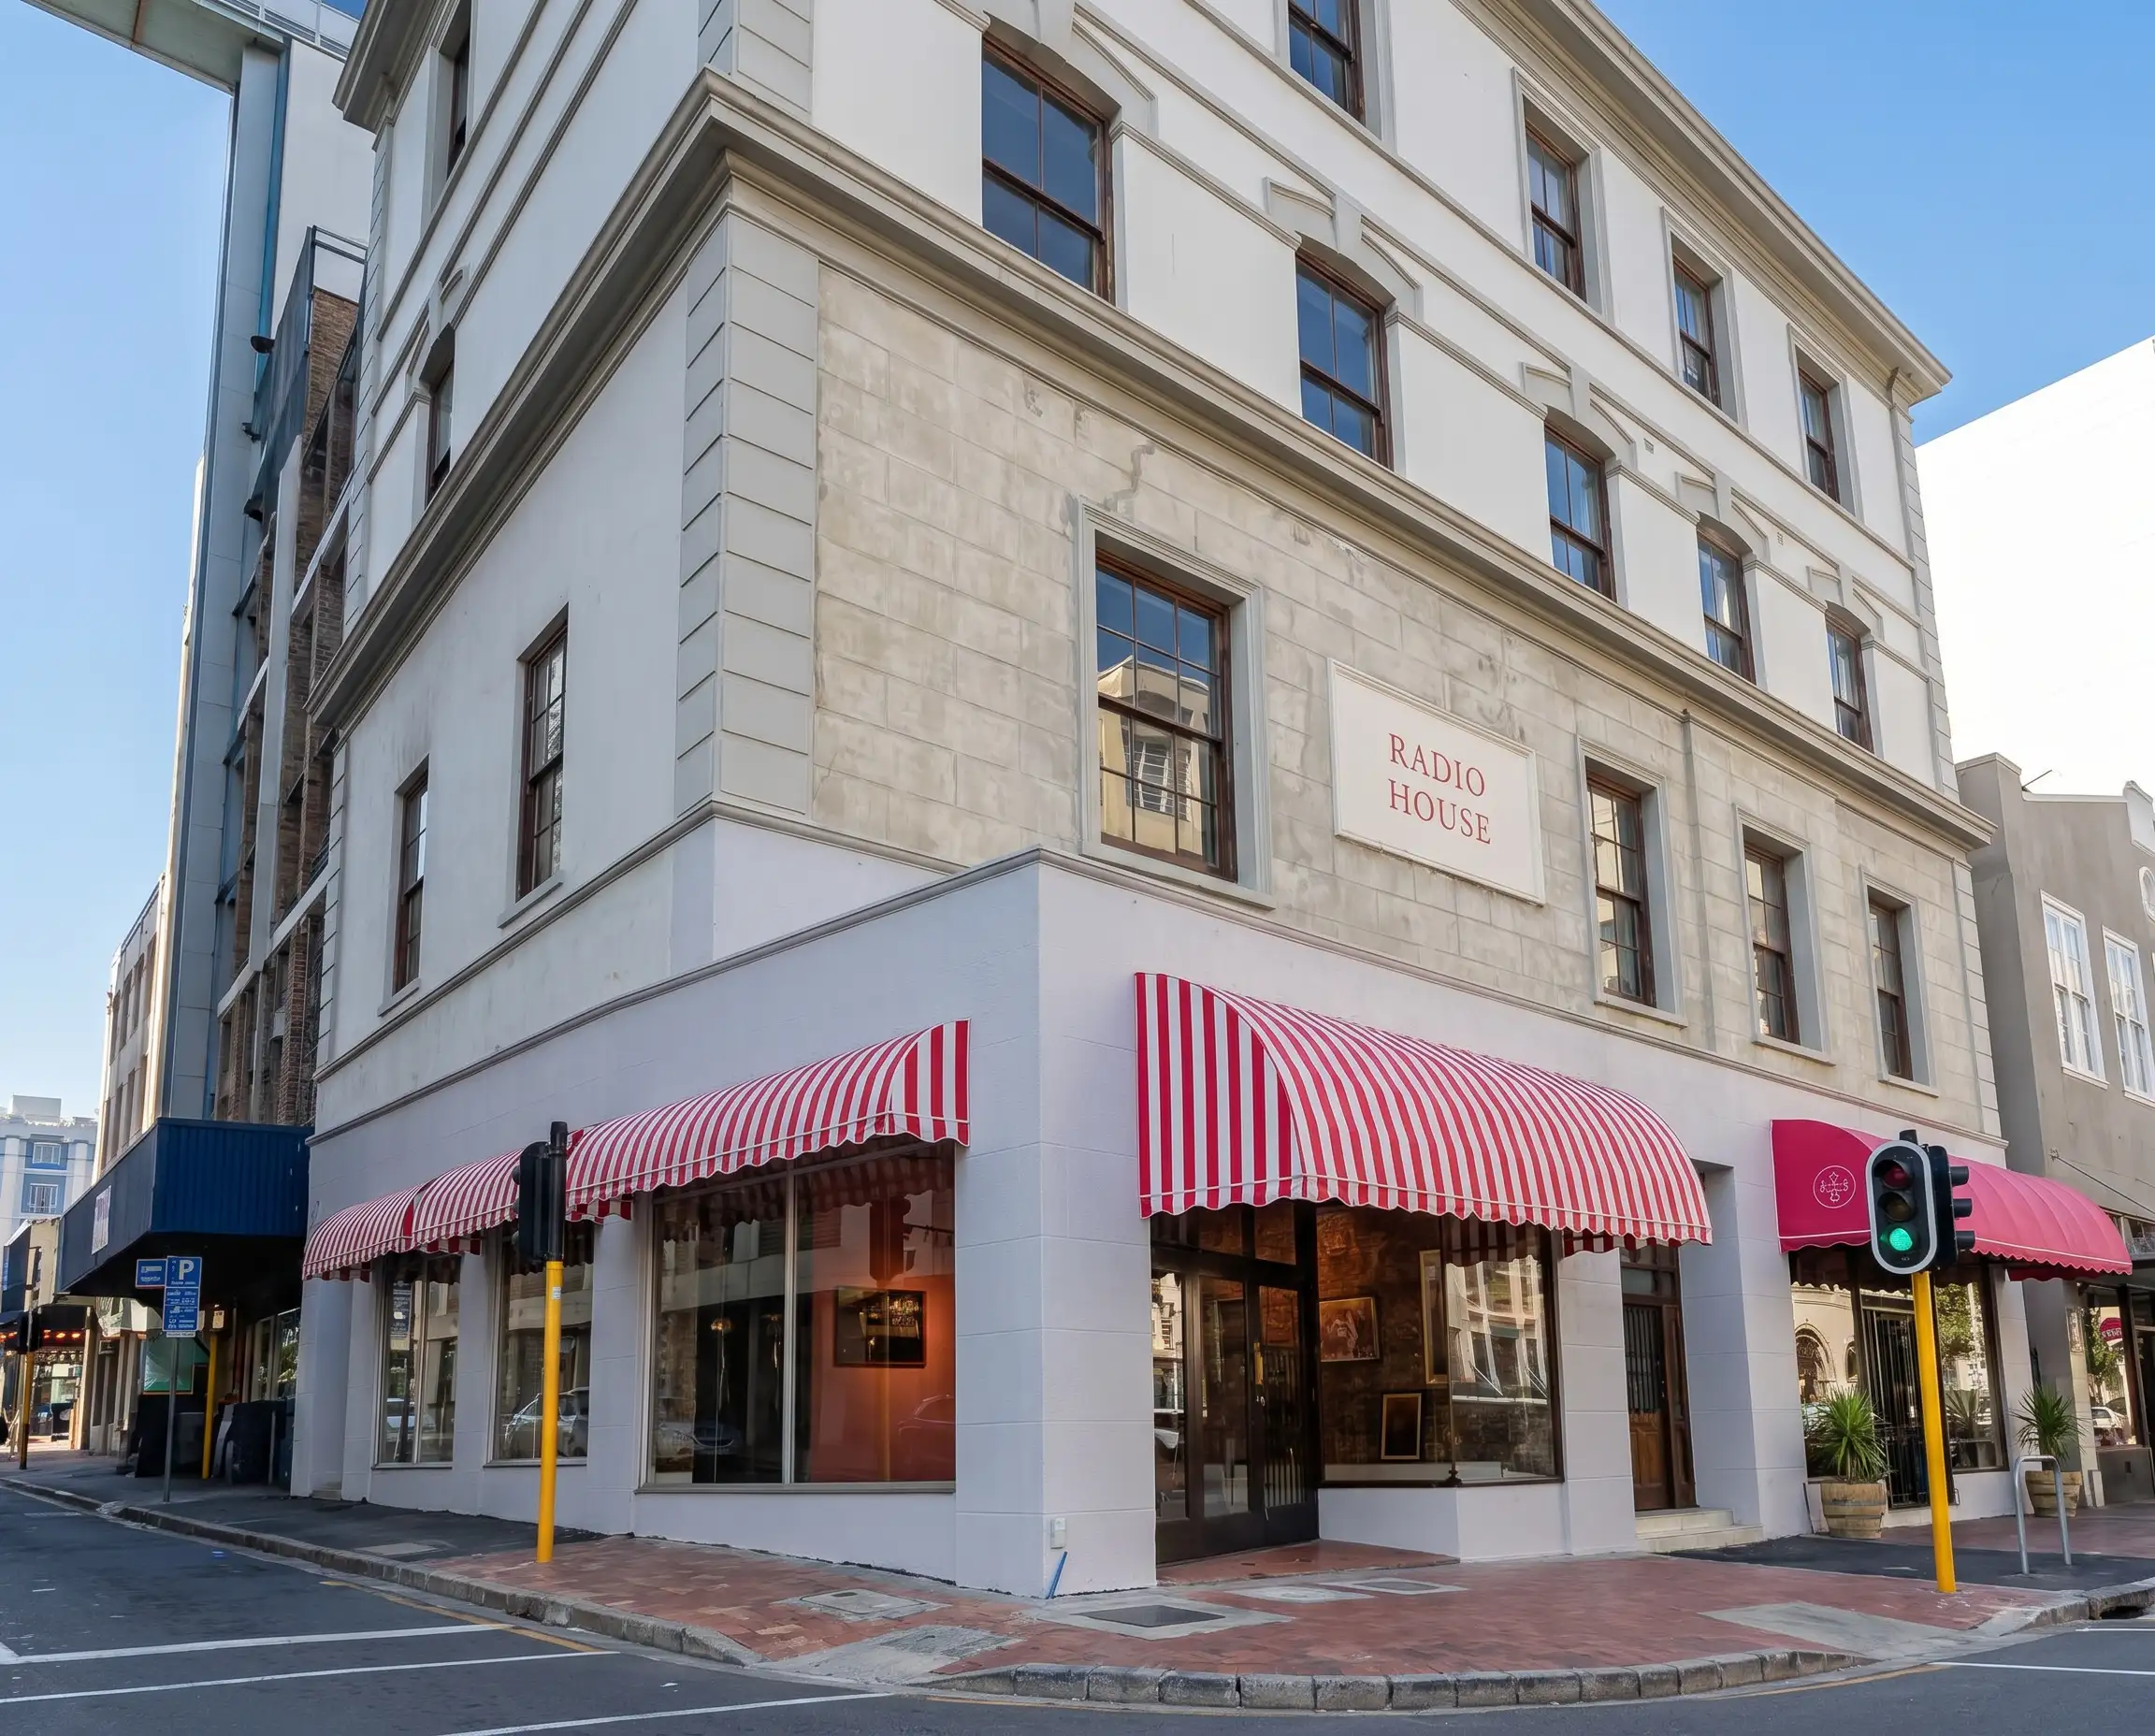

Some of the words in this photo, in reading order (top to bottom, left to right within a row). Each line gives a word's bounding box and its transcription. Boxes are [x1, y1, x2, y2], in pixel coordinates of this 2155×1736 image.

[1388, 732, 1485, 797] RADIO
[1388, 778, 1491, 845] HOUSE
[178, 1259, 194, 1280] P
